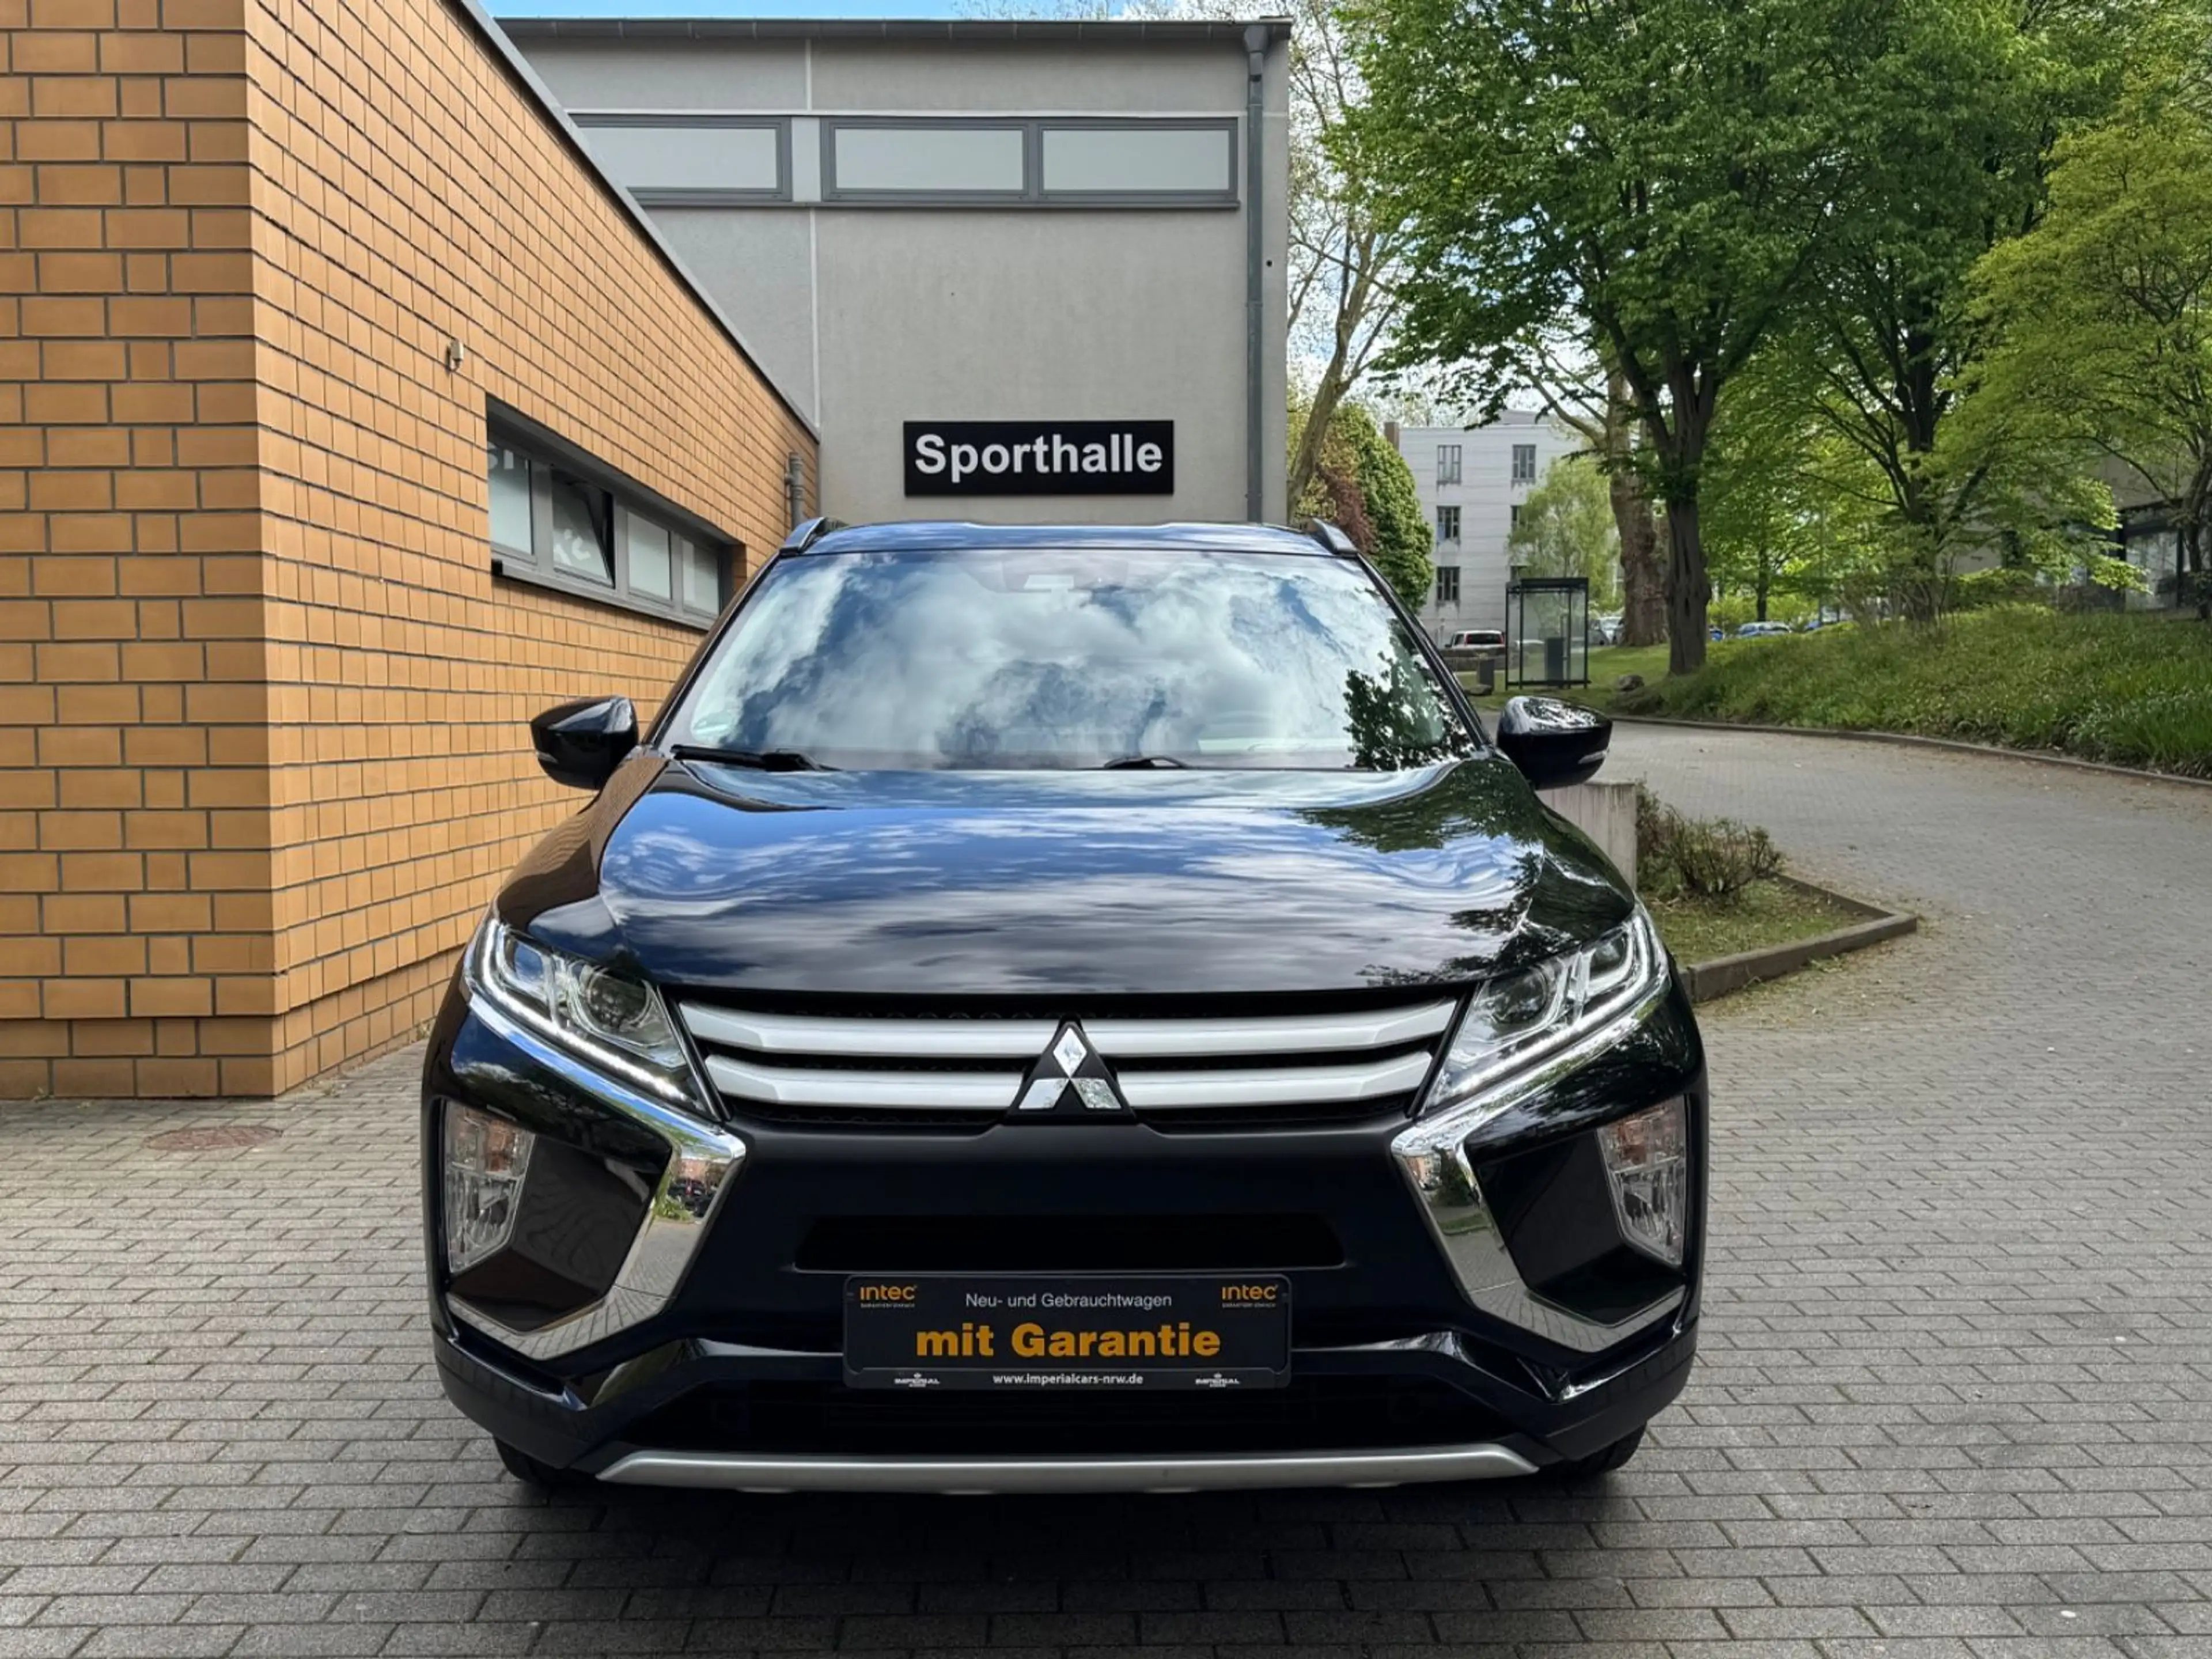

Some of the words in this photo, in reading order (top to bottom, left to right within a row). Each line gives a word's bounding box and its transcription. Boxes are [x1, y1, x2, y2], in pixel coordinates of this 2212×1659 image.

[915, 434, 1162, 483] Sporthalle
[859, 1285, 916, 1300] intec
[1222, 1285, 1277, 1300] intec
[965, 1293, 1003, 1307] Neu-
[1009, 1293, 1036, 1308] und
[1041, 1293, 1172, 1310] Gebrauchtwagen
[916, 1323, 994, 1356] mit
[1011, 1322, 1221, 1357] Garantie
[993, 1373, 1143, 1387] www.imperialcars-nrw.de
